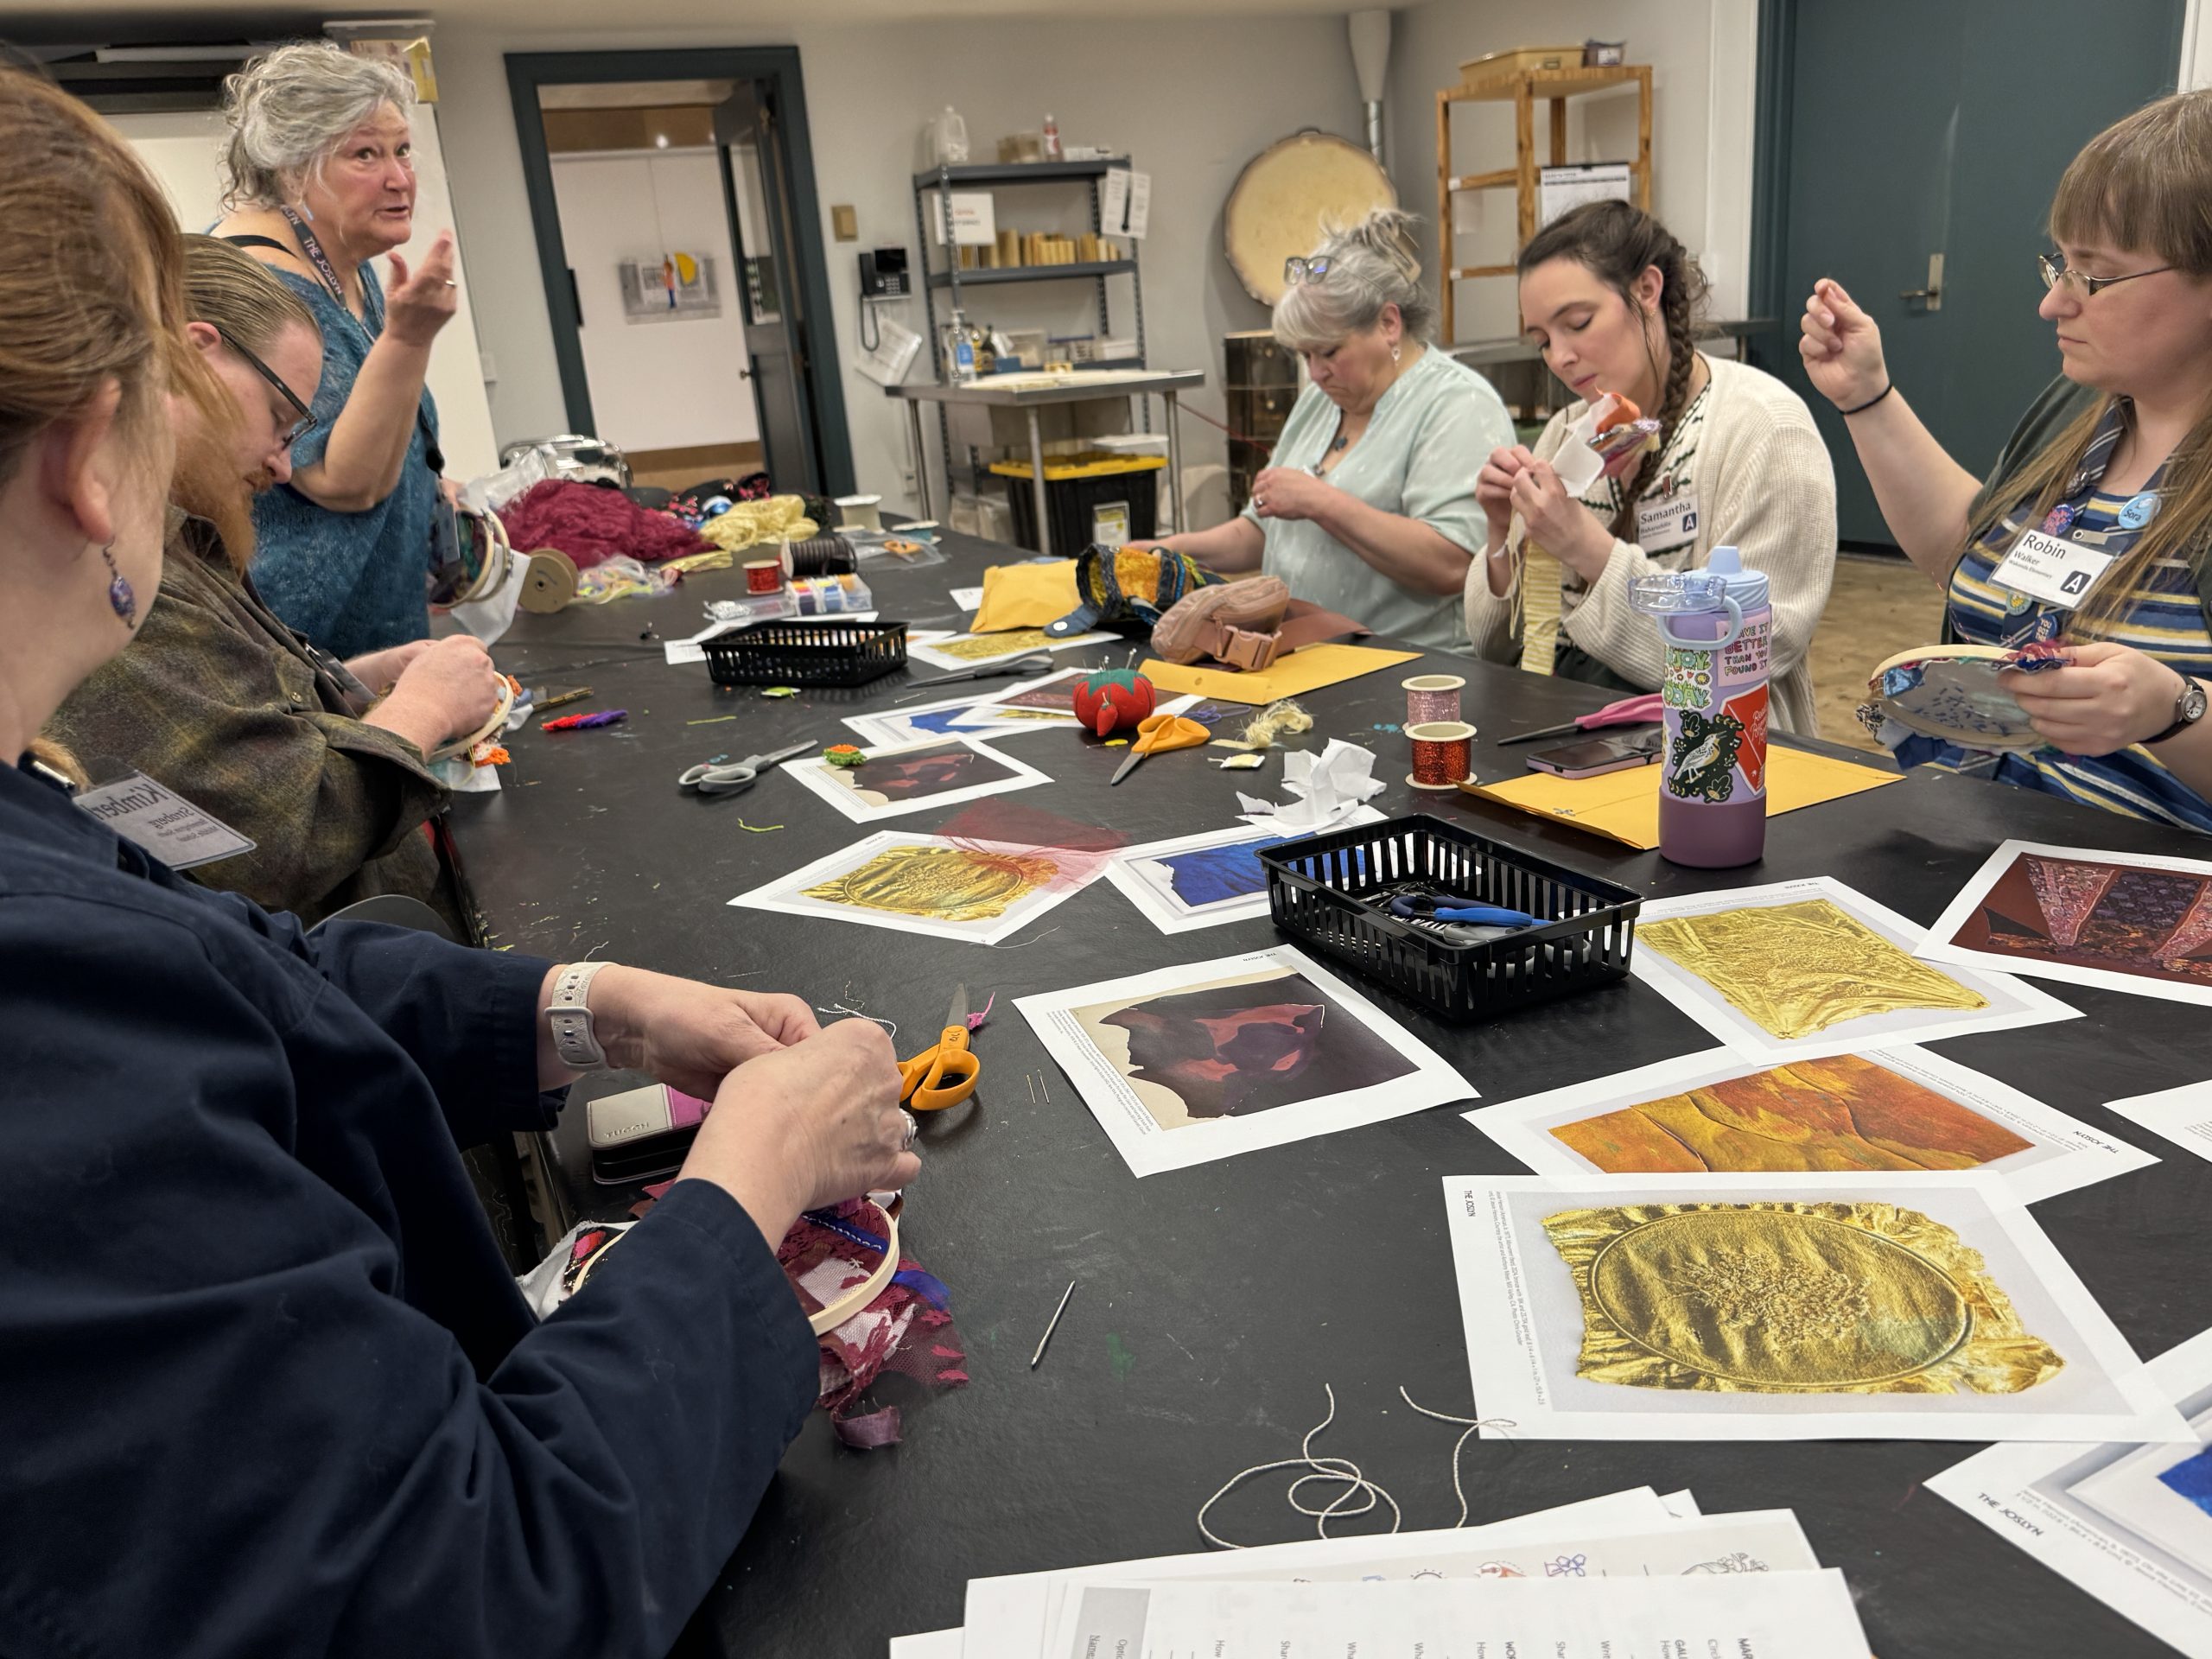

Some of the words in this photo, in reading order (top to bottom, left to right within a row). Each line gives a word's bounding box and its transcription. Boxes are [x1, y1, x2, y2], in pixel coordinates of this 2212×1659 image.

[1640, 502, 1691, 525] Samantha
[2124, 510, 2142, 522] Sora
[2023, 534, 2066, 560] Robin
[2013, 550, 2041, 566] Walker
[1725, 635, 1768, 654] BETTER
[1724, 652, 1751, 665] THAN
[1724, 662, 1758, 677] FOUND
[2073, 1130, 2105, 1145] JOSLYN
[2102, 1145, 2119, 1154] THE
[1464, 1190, 1473, 1199] THE
[1465, 1199, 1476, 1217] JOSLYN
[1978, 1492, 2000, 1509] THE
[1998, 1508, 2044, 1537] JOSLYN
[1215, 1639, 1225, 1658] How
